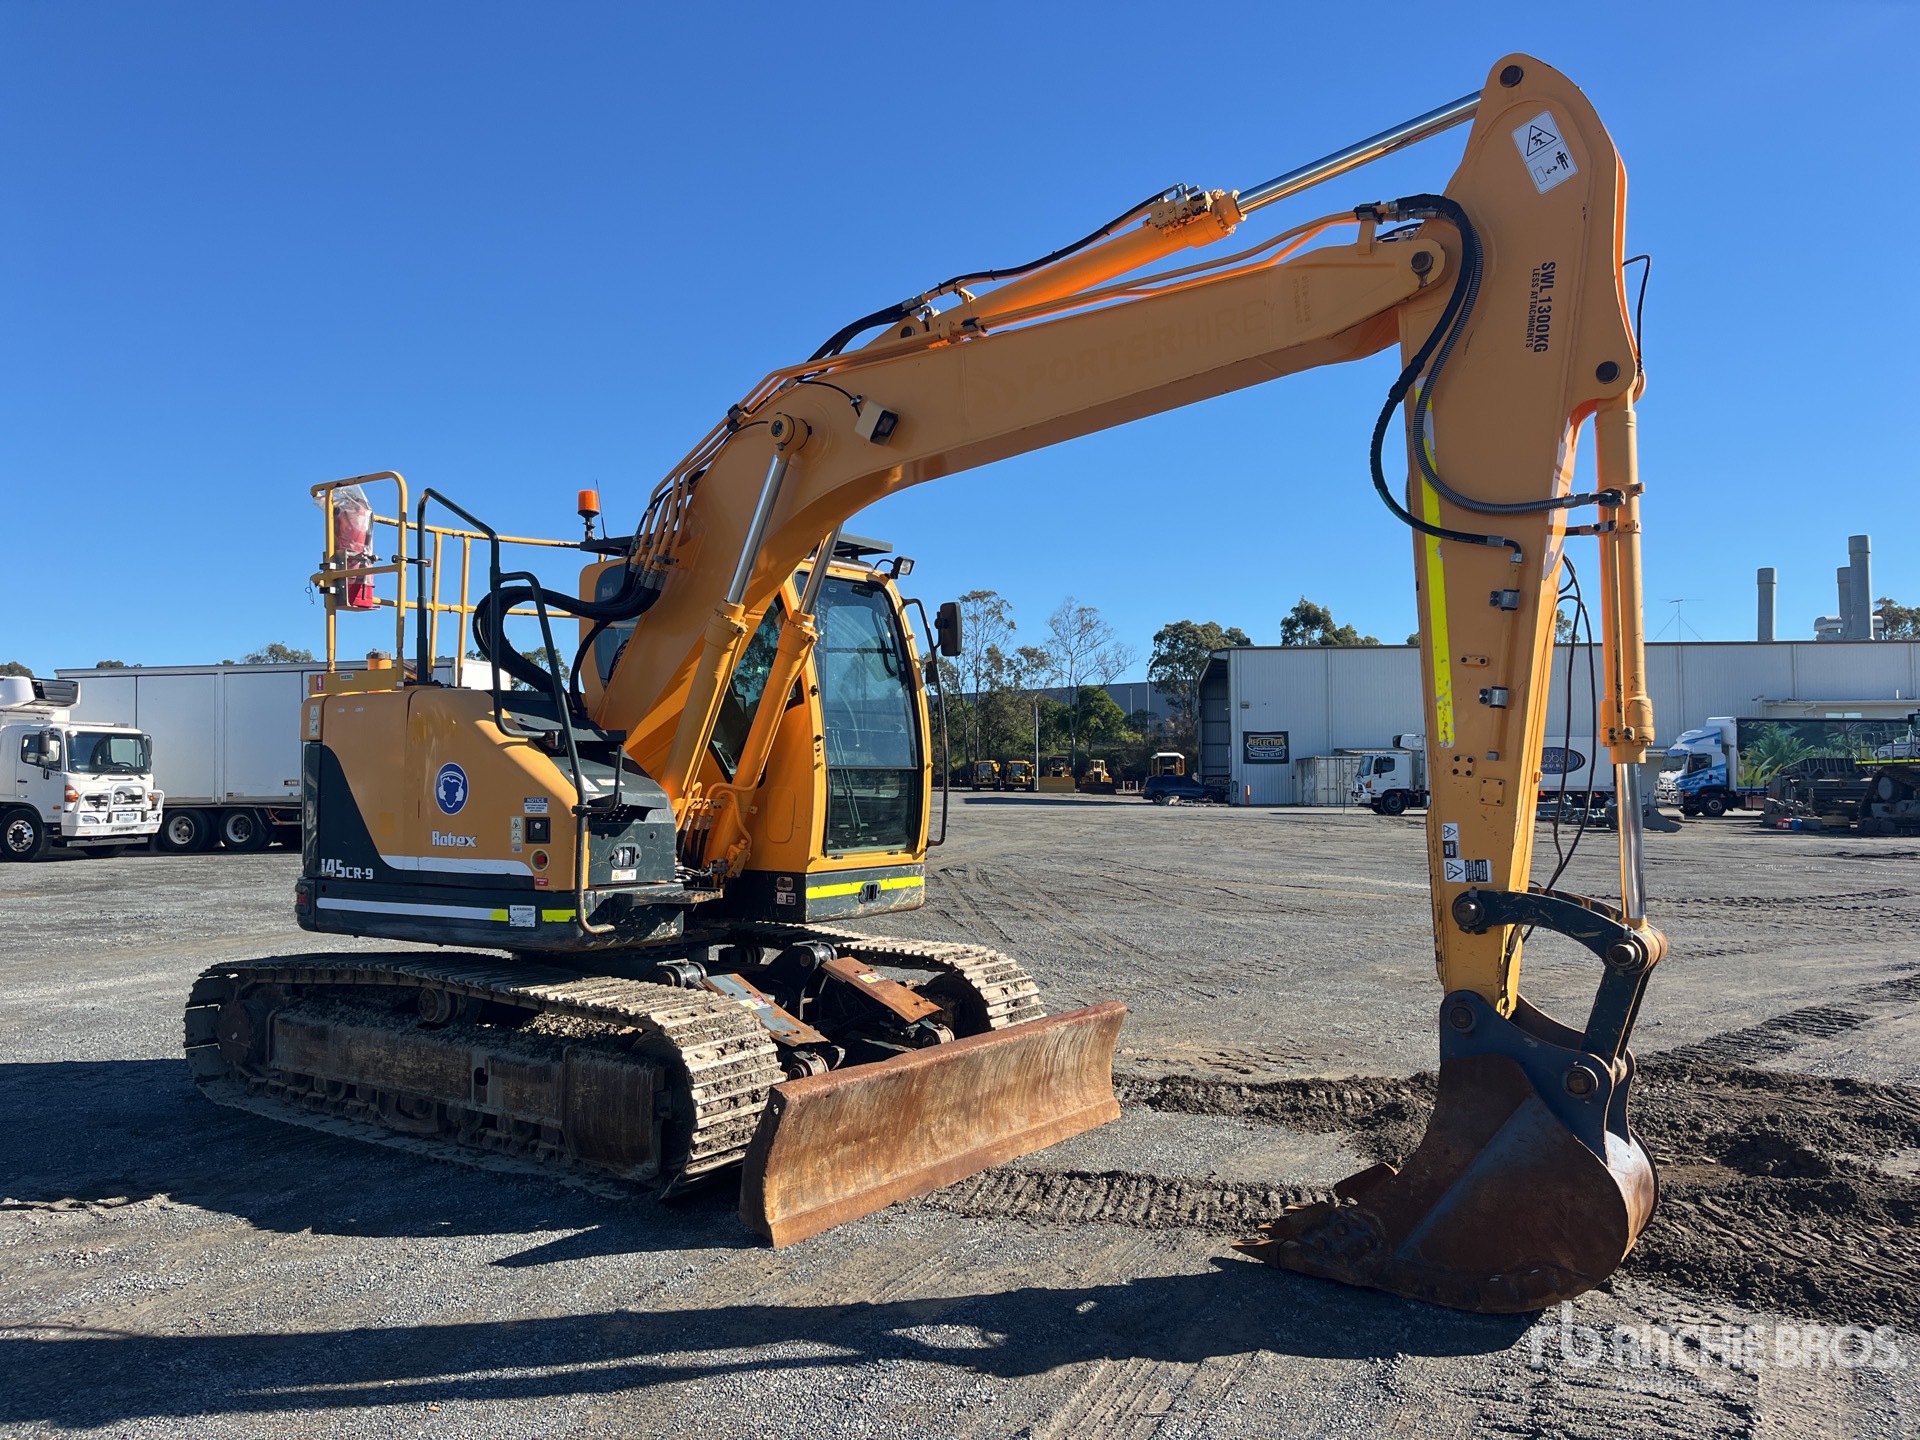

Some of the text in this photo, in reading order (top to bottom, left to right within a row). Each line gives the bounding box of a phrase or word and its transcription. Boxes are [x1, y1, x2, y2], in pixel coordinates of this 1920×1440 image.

[1525, 267, 1541, 349] LESS ATTACHMENTS
[1533, 261, 1556, 353] SWL 1300KG
[1248, 738, 1284, 746] REFLECTION
[431, 830, 477, 847] Robex
